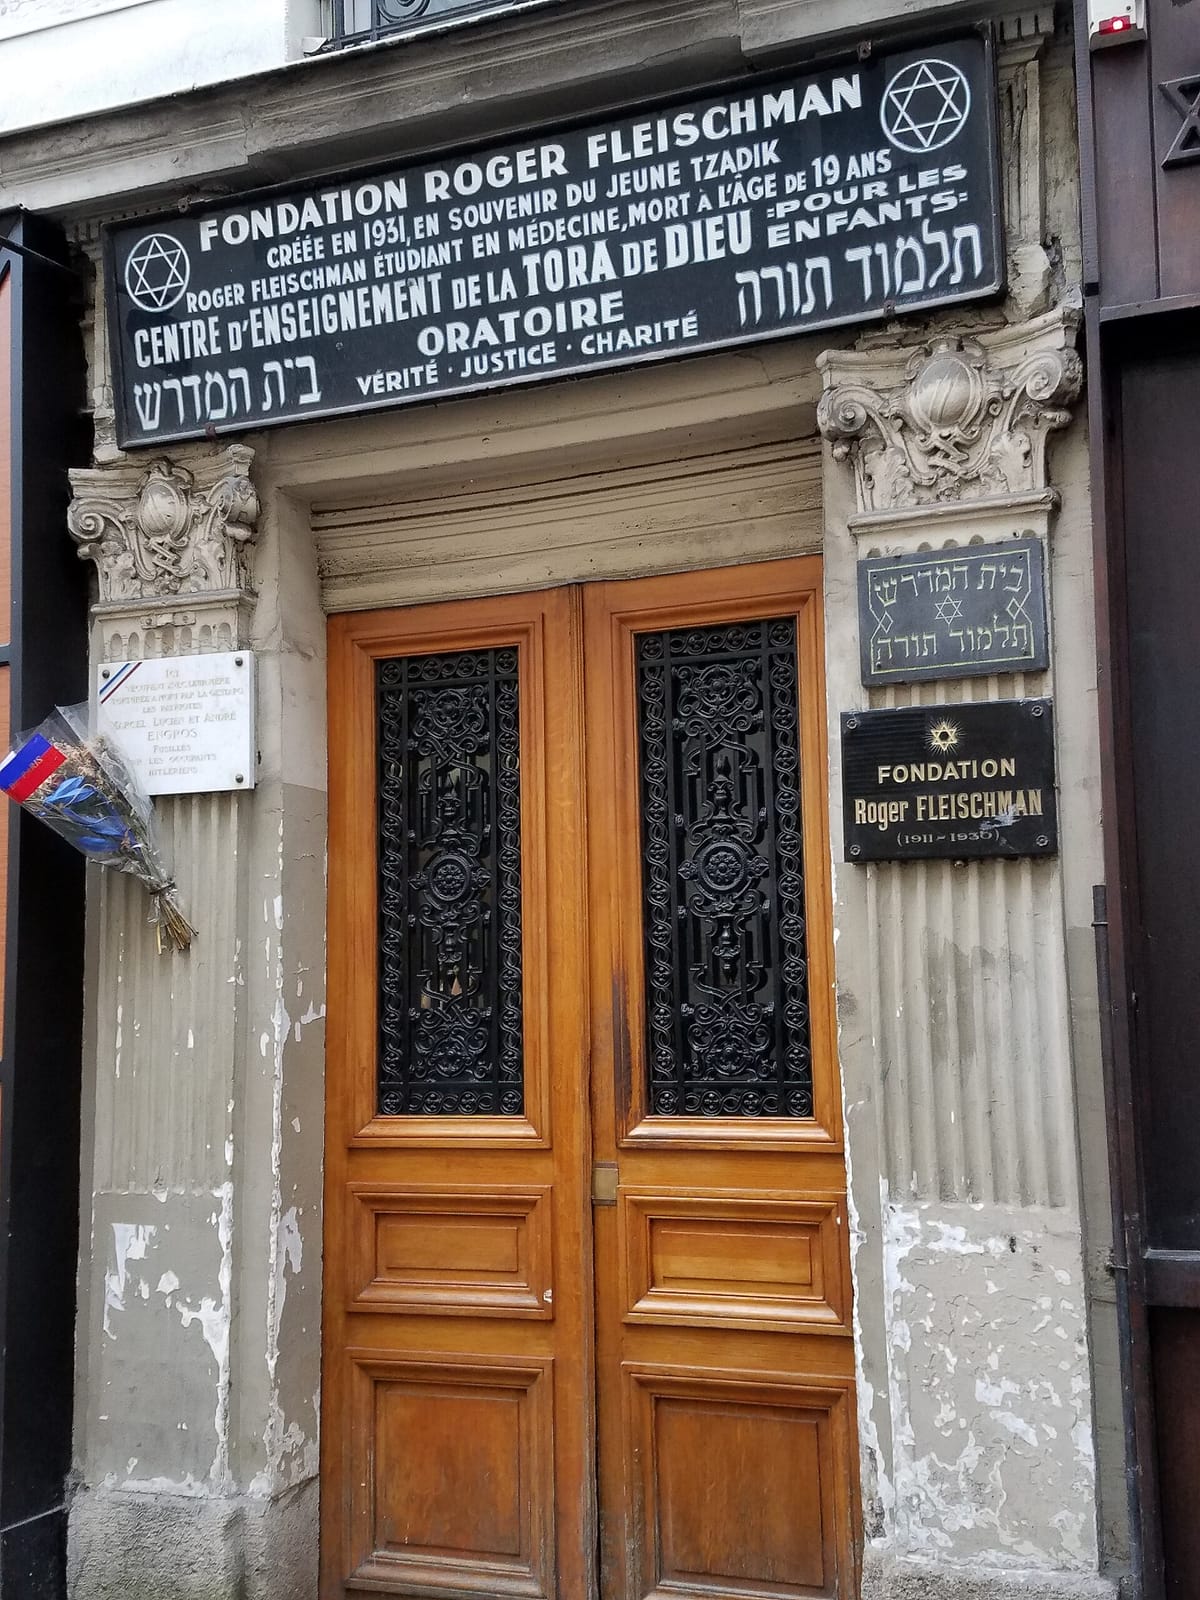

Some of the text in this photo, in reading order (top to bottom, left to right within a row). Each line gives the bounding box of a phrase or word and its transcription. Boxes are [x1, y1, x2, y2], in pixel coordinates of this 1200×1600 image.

[200, 73, 863, 252] FONDATION ROGER FLEISCHMAN
[898, 163, 968, 194] LES
[186, 283, 245, 314] ROGER
[251, 259, 366, 303] FLEISCHMAN
[374, 238, 463, 278] ÉTUDIANT
[472, 231, 500, 259] EN
[628, 192, 690, 228] MORT
[697, 188, 715, 213] À
[718, 173, 777, 208] L'ÂGE
[785, 170, 807, 194] DE
[811, 155, 841, 188] 19
[846, 149, 892, 181] ANS
[266, 138, 782, 268] CRÉÉE EN 1931, EN SOUVENIR DU JEUNE TZADIK
[134, 206, 752, 369] CENTRE D'ENSEIGNEMENT DE LA TORA DE DIEU
[735, 218, 982, 327] תלמוד תורה
[355, 309, 698, 396] VÉRITÉ JUSTICE CHARITÉ
[417, 290, 624, 356] ORATOIRE
[134, 355, 322, 431] בית המדרש
[874, 562, 1024, 607] בית המדרש
[877, 613, 1027, 660] תלמוד תורה
[147, 728, 198, 742] ENGROS
[878, 758, 1016, 784] FONDATION
[854, 788, 1044, 831] Roger FLEISCHMAN
